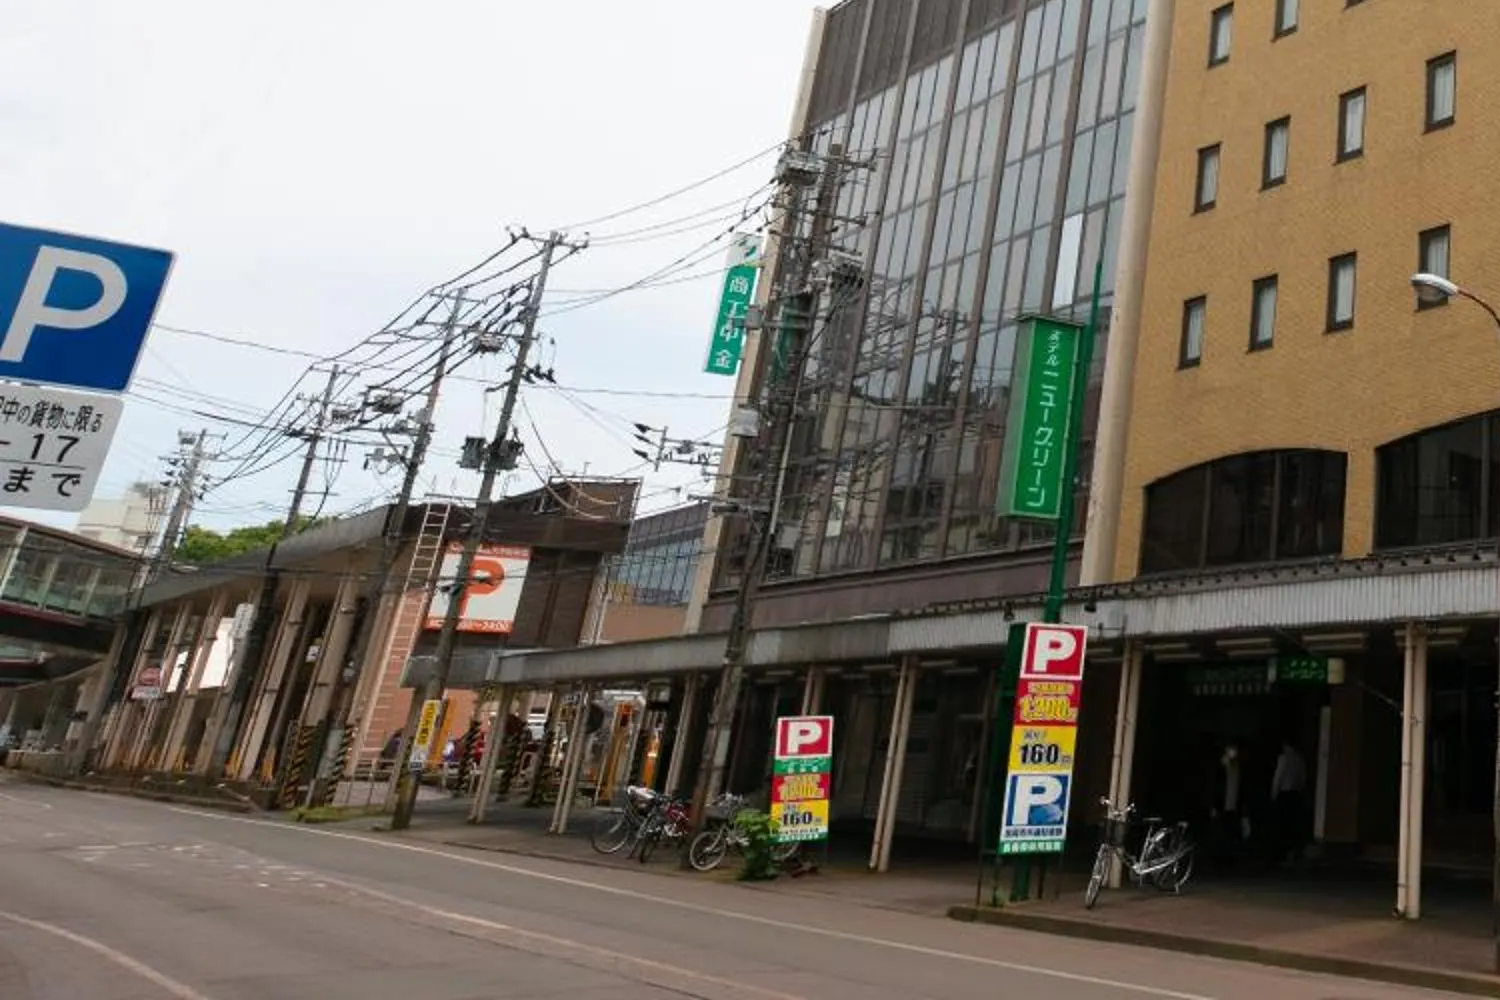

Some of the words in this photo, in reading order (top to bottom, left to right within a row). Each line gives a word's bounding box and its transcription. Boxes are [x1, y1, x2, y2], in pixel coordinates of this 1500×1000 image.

[0, 245, 128, 363] P
[715, 275, 750, 369] 商工中金
[0, 395, 104, 433] 中の貨物に限る
[3, 466, 83, 497] まで
[458, 558, 505, 620] P
[1032, 629, 1077, 673] P
[786, 721, 823, 755] P
[1012, 775, 1063, 826] P
